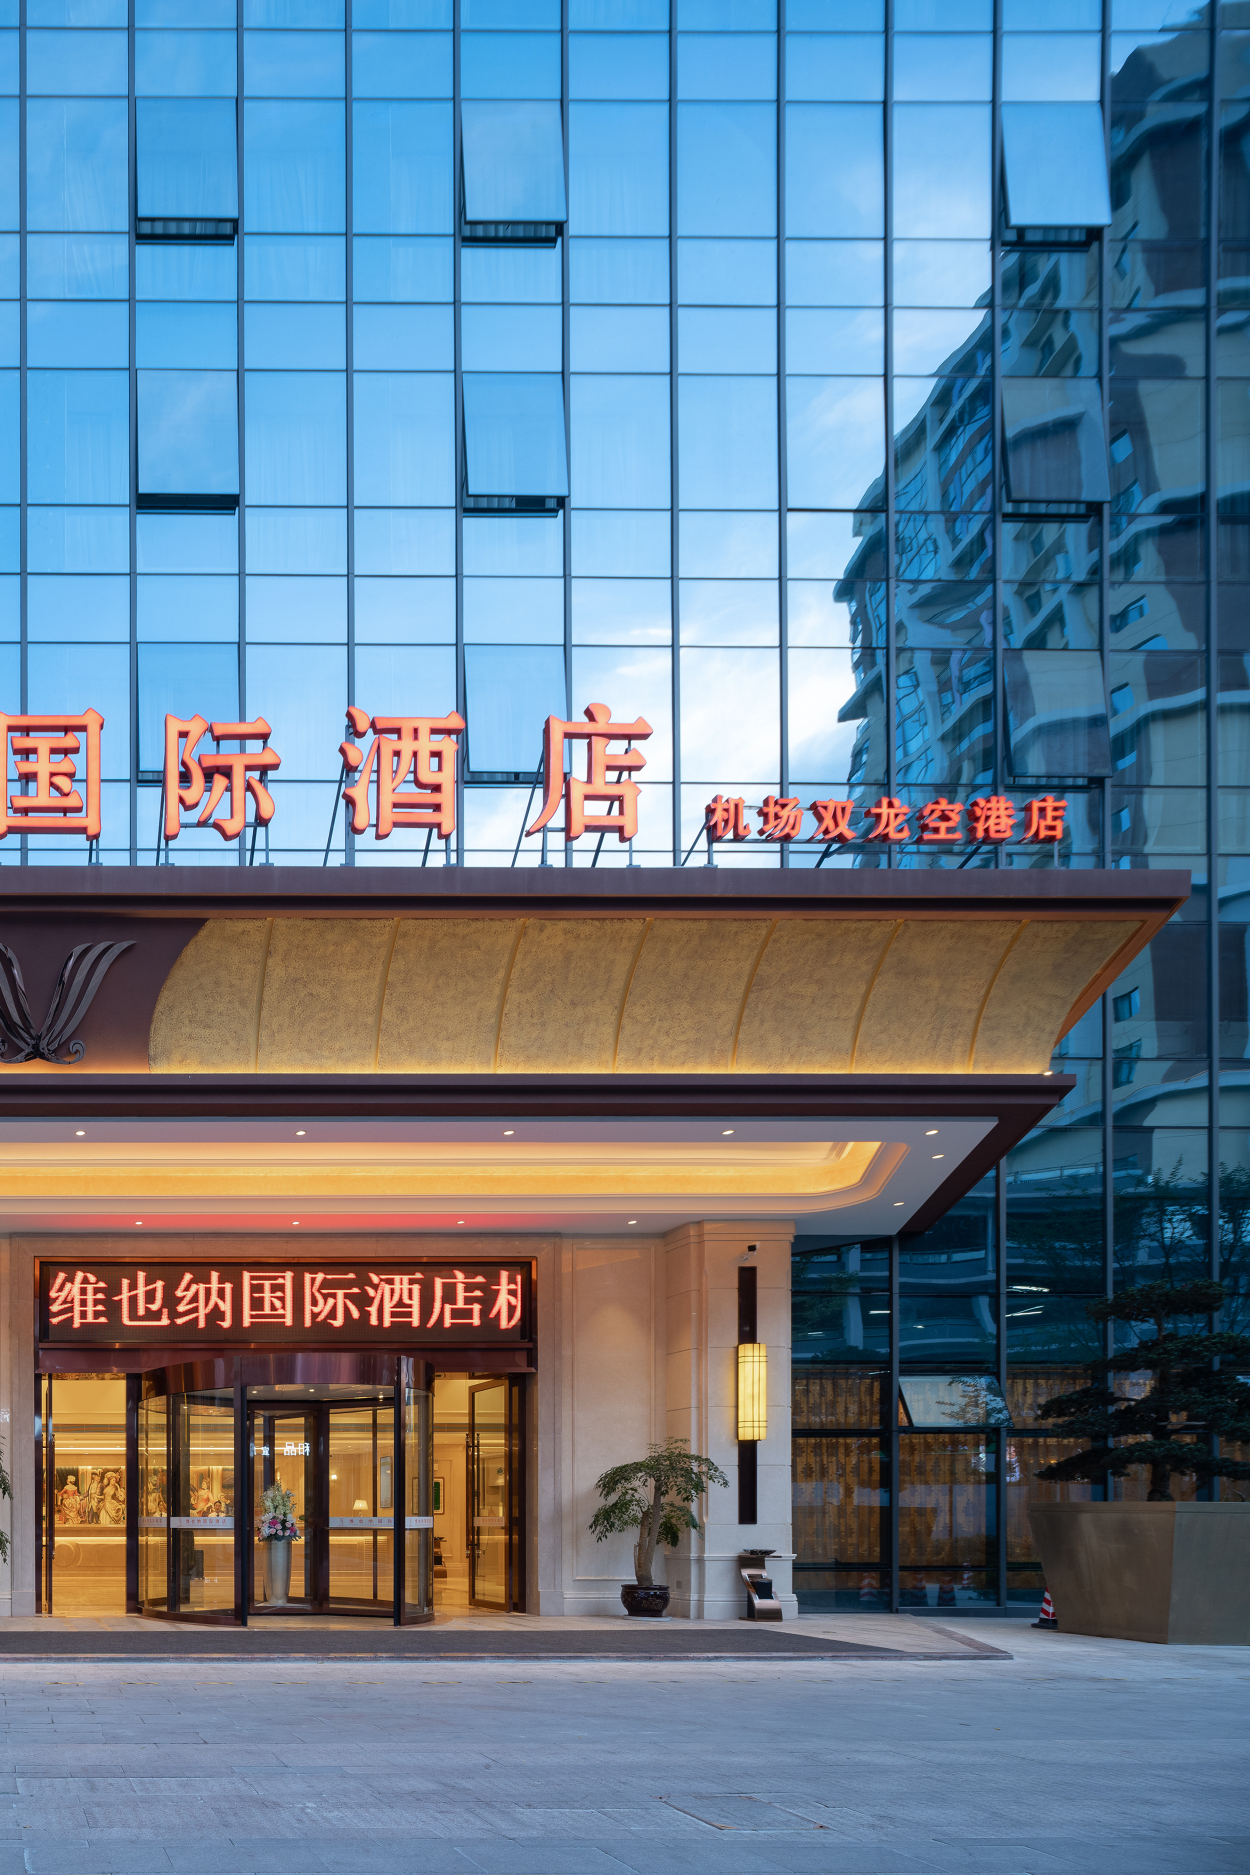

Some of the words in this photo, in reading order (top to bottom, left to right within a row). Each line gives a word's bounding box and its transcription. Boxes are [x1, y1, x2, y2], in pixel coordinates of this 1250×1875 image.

[706, 793, 1068, 845] 机场双龙空港店
